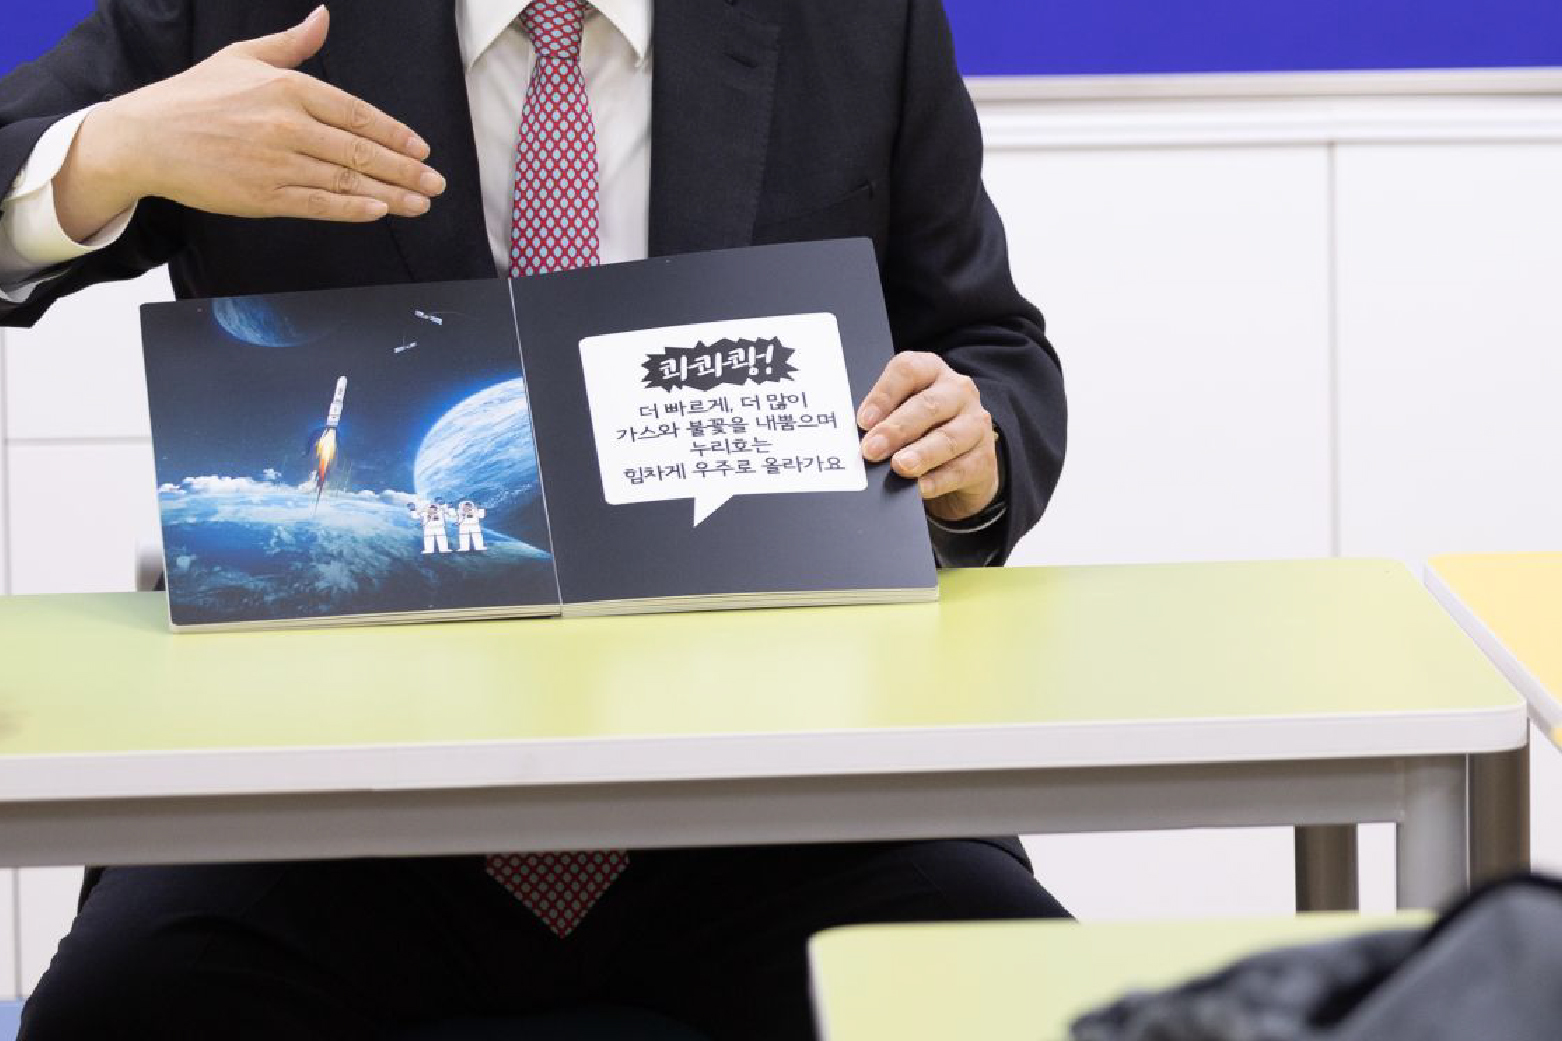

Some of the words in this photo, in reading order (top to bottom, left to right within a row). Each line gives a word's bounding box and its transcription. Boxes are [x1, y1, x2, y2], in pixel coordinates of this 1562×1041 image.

[658, 344, 775, 382] 콰콰쾅!
[639, 403, 660, 418] 더
[664, 396, 734, 415] 빠르게,
[740, 393, 761, 410] 더
[766, 391, 809, 410] 많이
[616, 421, 680, 442] 가스와
[687, 415, 749, 437] 불꽃을
[755, 411, 838, 431] 내뿜으며
[690, 437, 773, 456] 누리호는
[624, 462, 687, 485] 힘차게
[692, 459, 757, 477] 우주로
[762, 455, 846, 475] 올라가요
